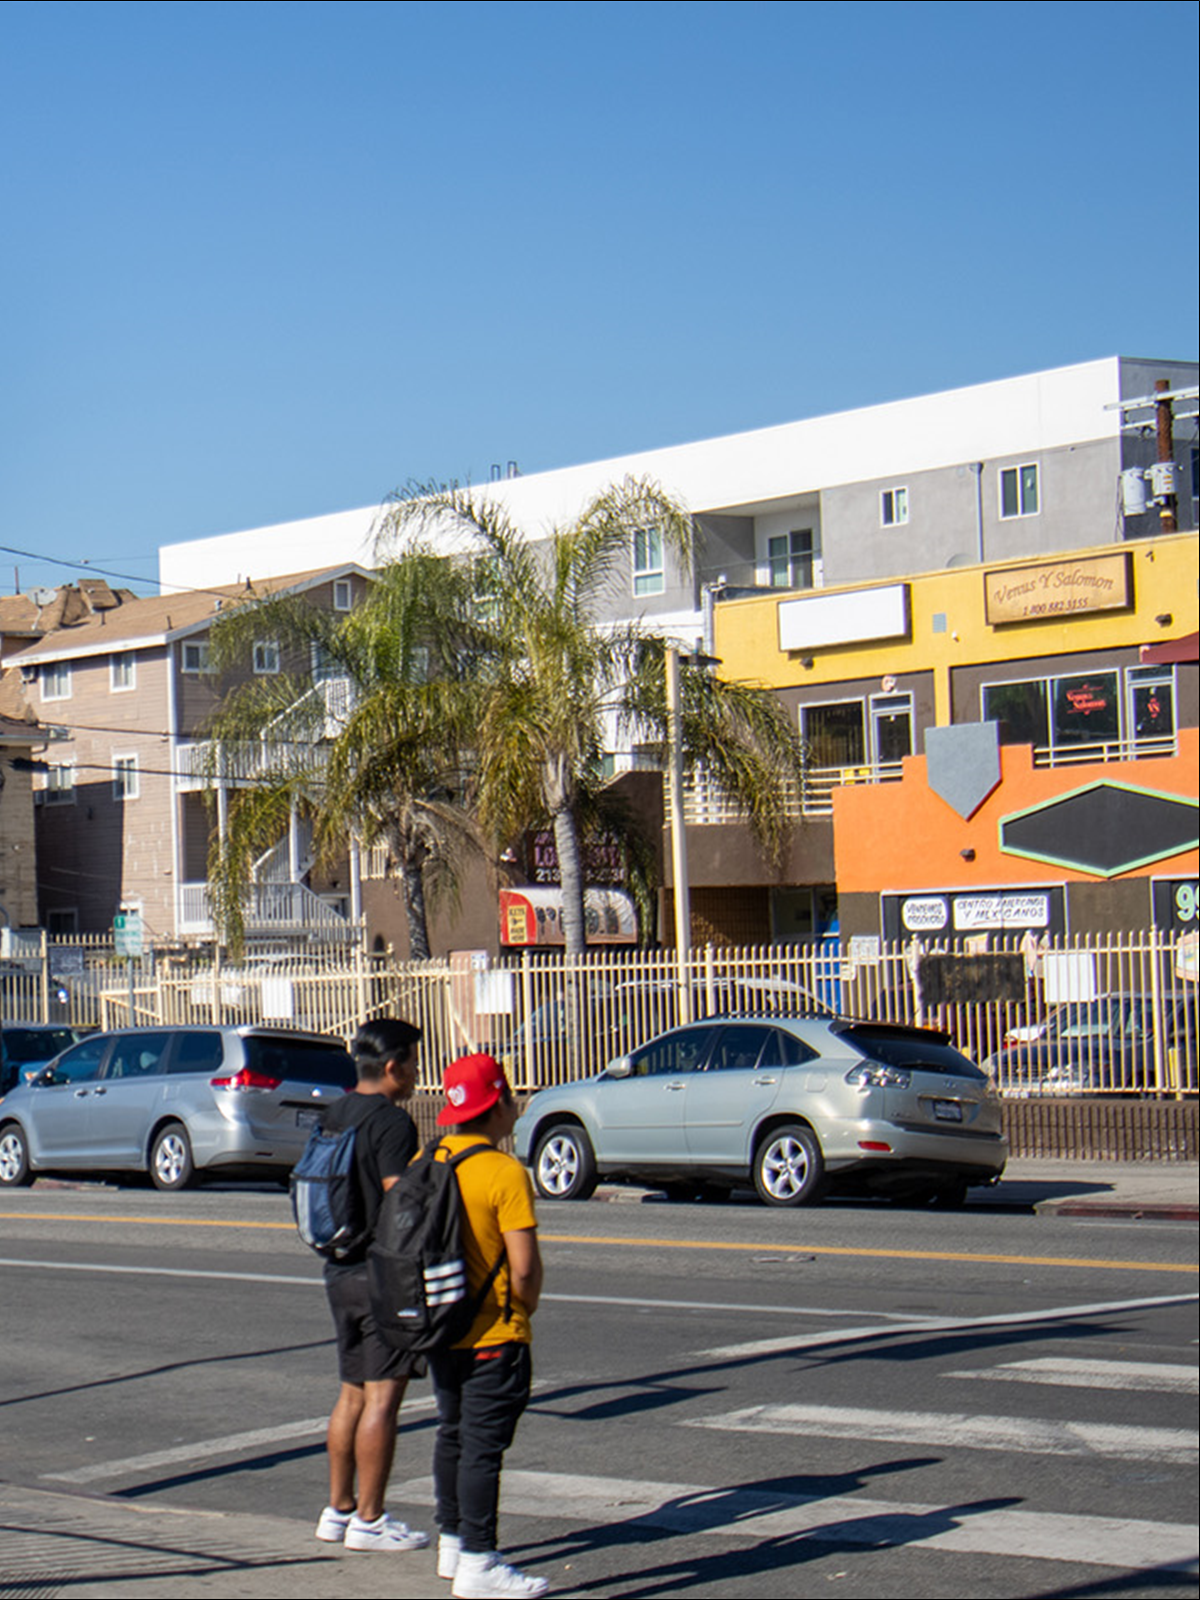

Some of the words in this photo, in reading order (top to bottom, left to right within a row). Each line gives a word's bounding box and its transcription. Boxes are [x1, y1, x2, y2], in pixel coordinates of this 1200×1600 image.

[993, 580, 1036, 604] Venus
[1039, 572, 1053, 588] Y
[1053, 569, 1114, 590] Salomon
[1176, 885, 1199, 922] 9
